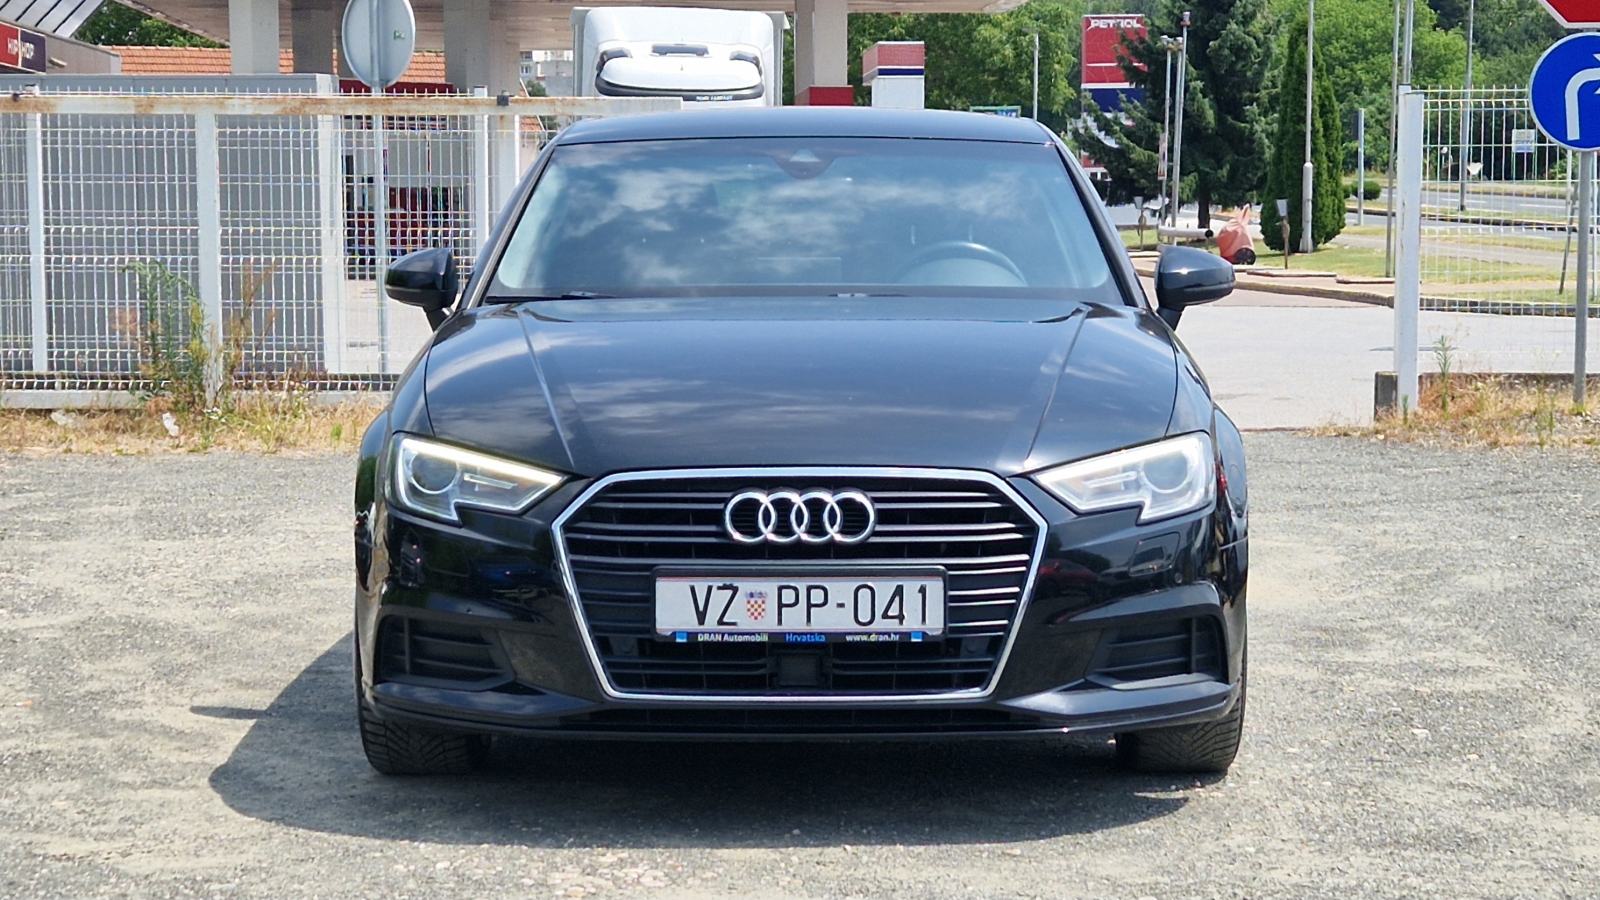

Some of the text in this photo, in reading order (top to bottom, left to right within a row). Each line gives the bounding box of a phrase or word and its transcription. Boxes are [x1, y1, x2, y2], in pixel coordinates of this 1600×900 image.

[777, 583, 927, 627] PP-041
[697, 633, 900, 643] DRAN Automobili Hrvatska www.dran.hr
